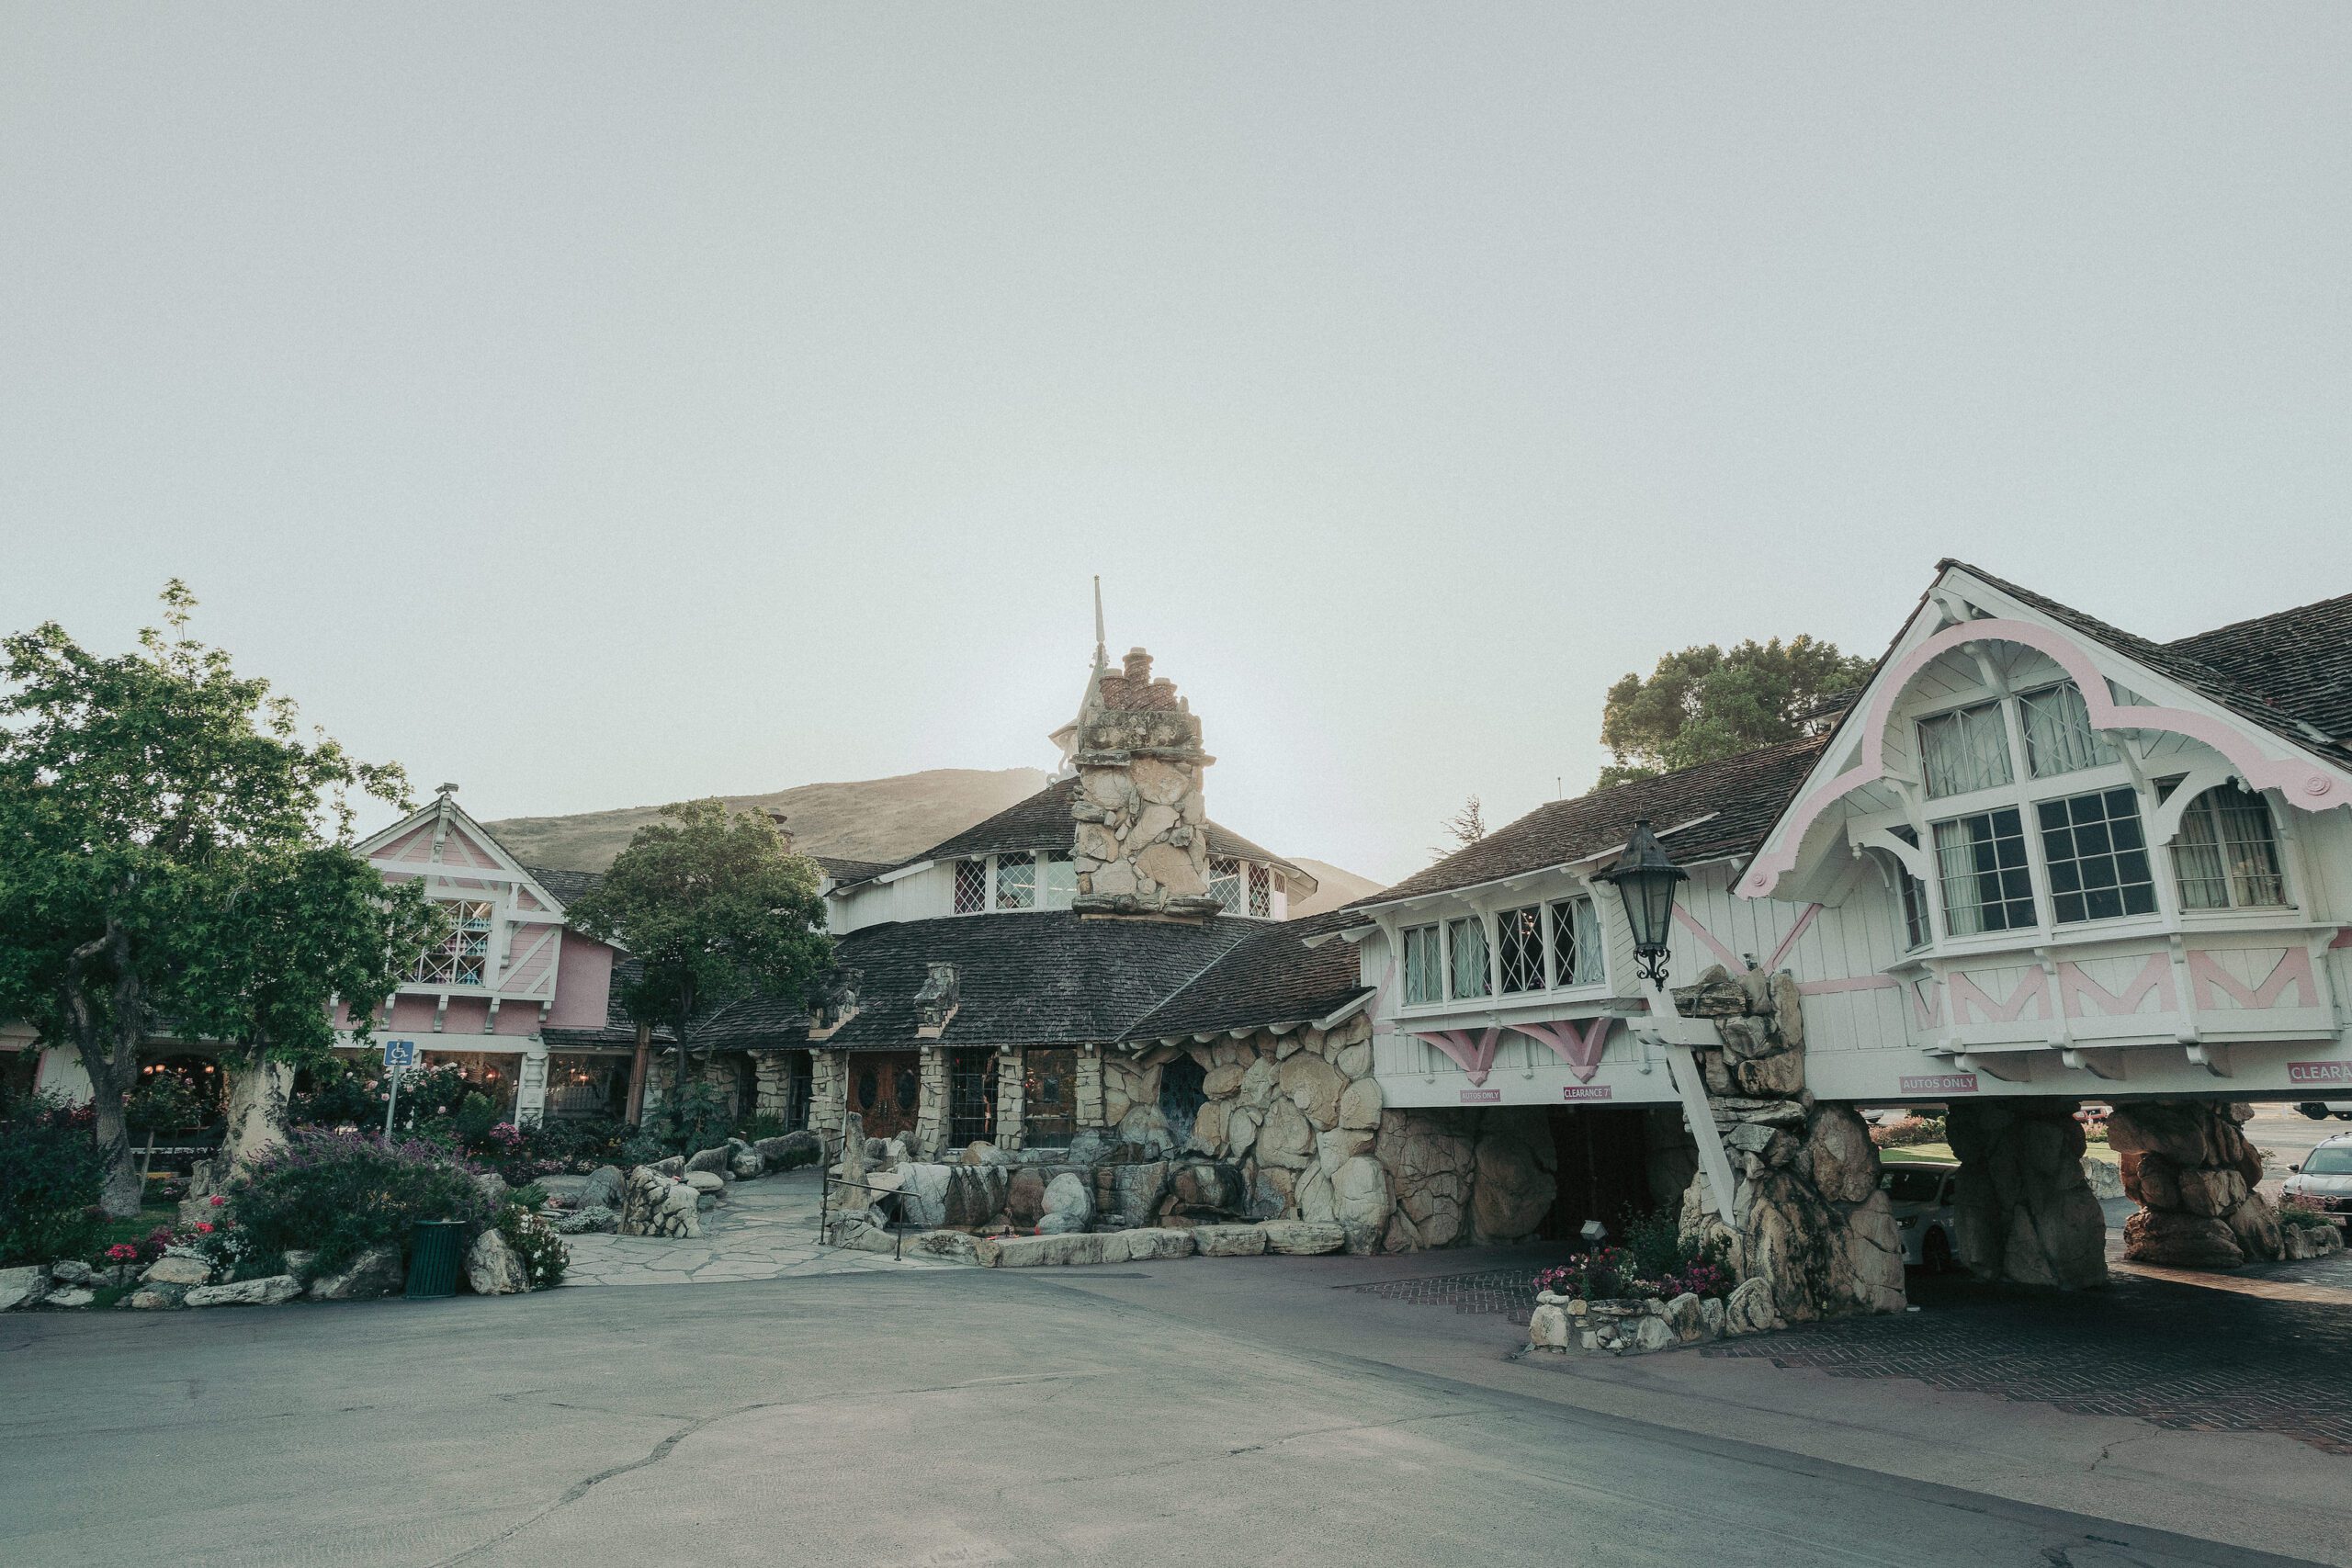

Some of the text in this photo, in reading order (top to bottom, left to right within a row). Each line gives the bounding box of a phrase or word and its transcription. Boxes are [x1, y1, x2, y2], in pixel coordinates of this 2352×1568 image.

[1903, 1077, 1973, 1089] AUTOS ONLY
[1565, 1089, 1602, 1098] CLEARANCE
